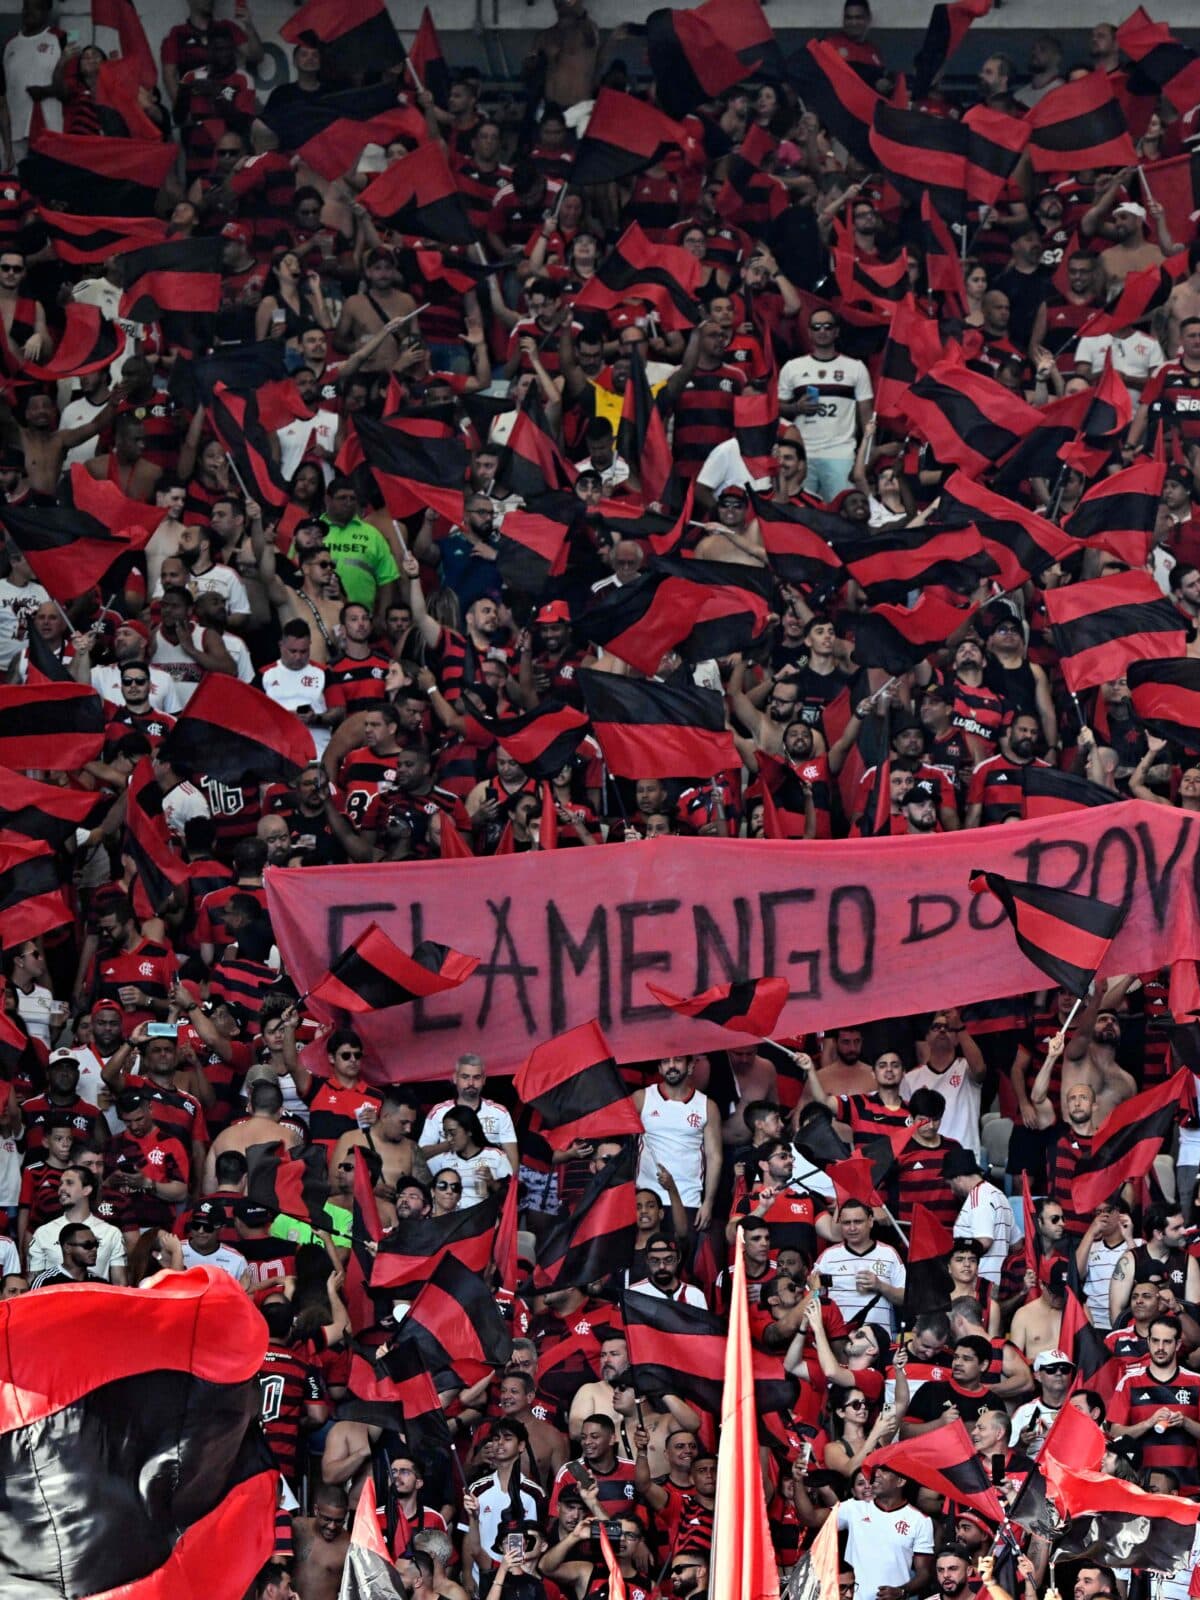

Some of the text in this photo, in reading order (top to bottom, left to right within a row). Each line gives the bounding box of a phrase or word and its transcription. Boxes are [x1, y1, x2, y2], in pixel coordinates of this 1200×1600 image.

[1041, 248, 1064, 265] S2
[811, 403, 838, 418] S2
[326, 885, 876, 1037] FLAMENGO
[901, 890, 1007, 944] DO
